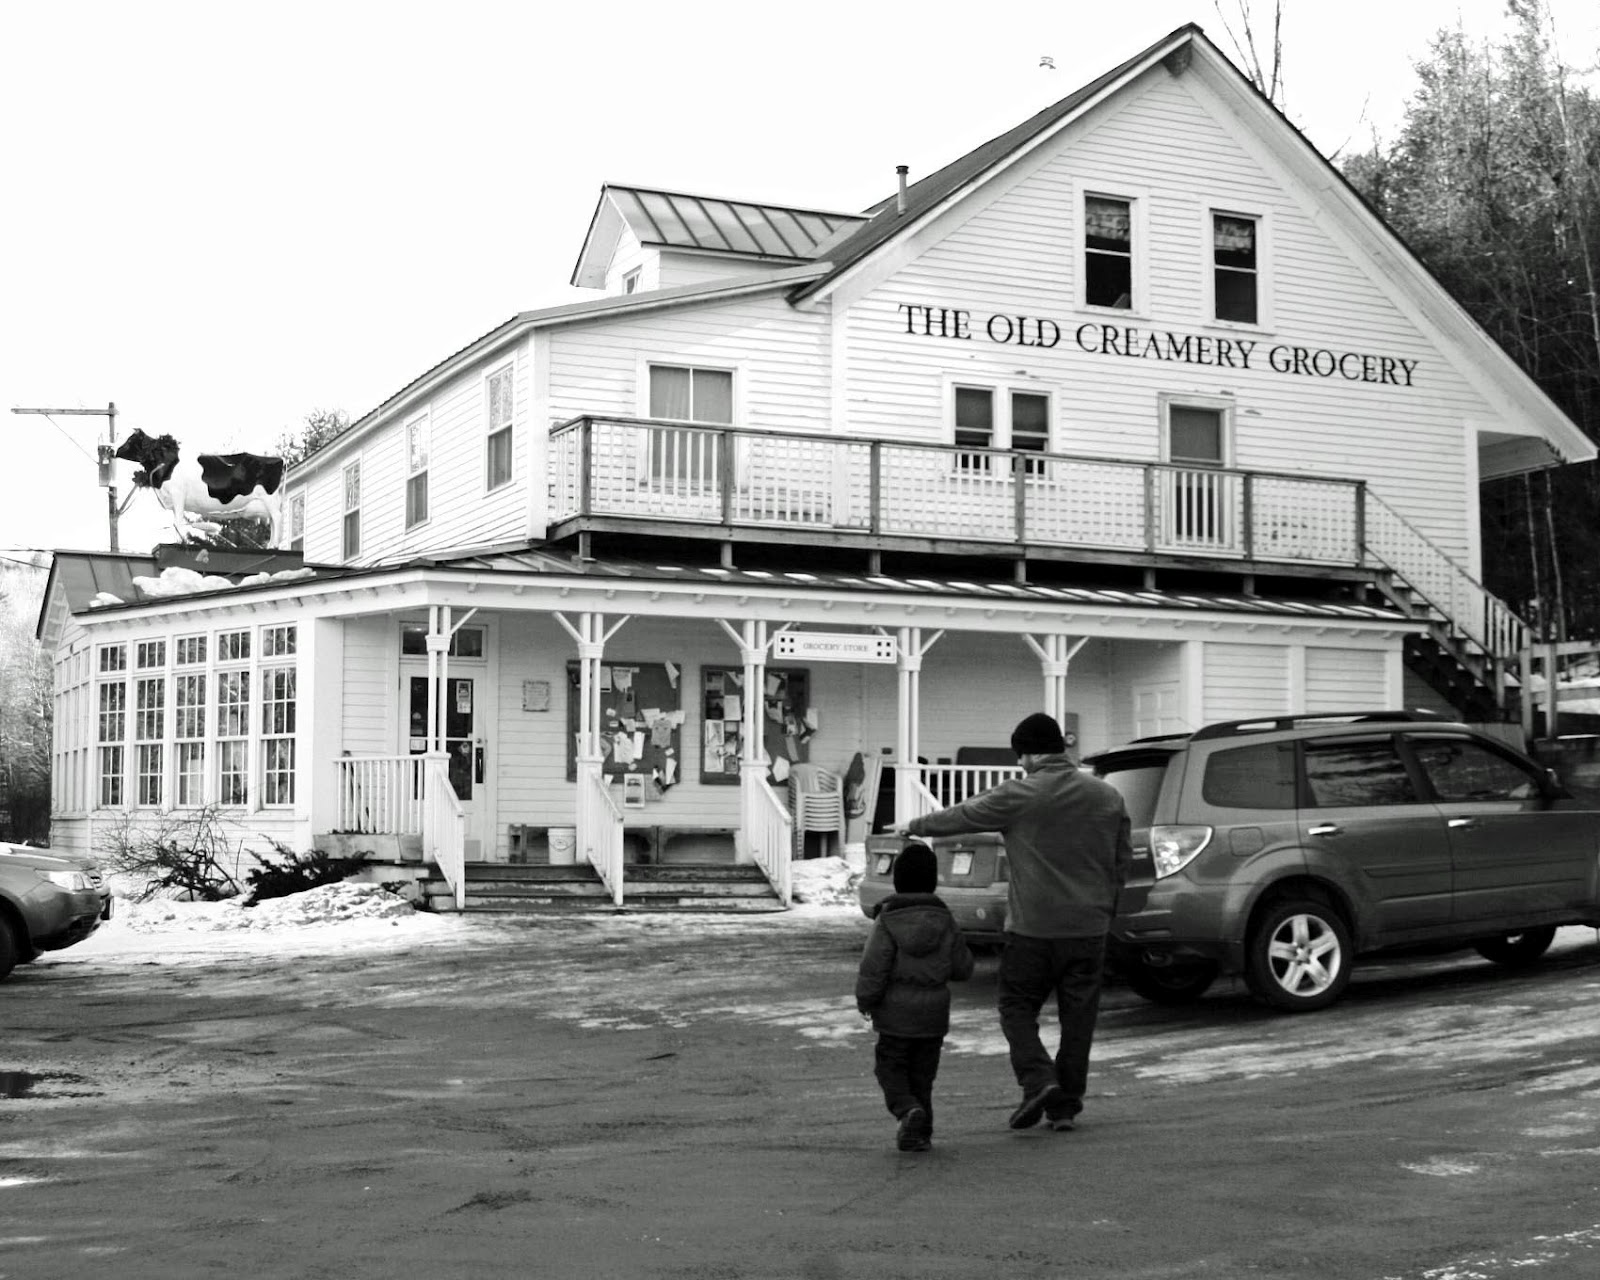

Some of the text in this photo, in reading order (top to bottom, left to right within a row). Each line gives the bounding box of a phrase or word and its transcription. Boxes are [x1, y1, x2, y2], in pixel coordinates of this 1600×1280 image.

[898, 304, 1420, 387] THE OLD CREAMERY GROCERY
[803, 642, 868, 652] GROCERY STORE
